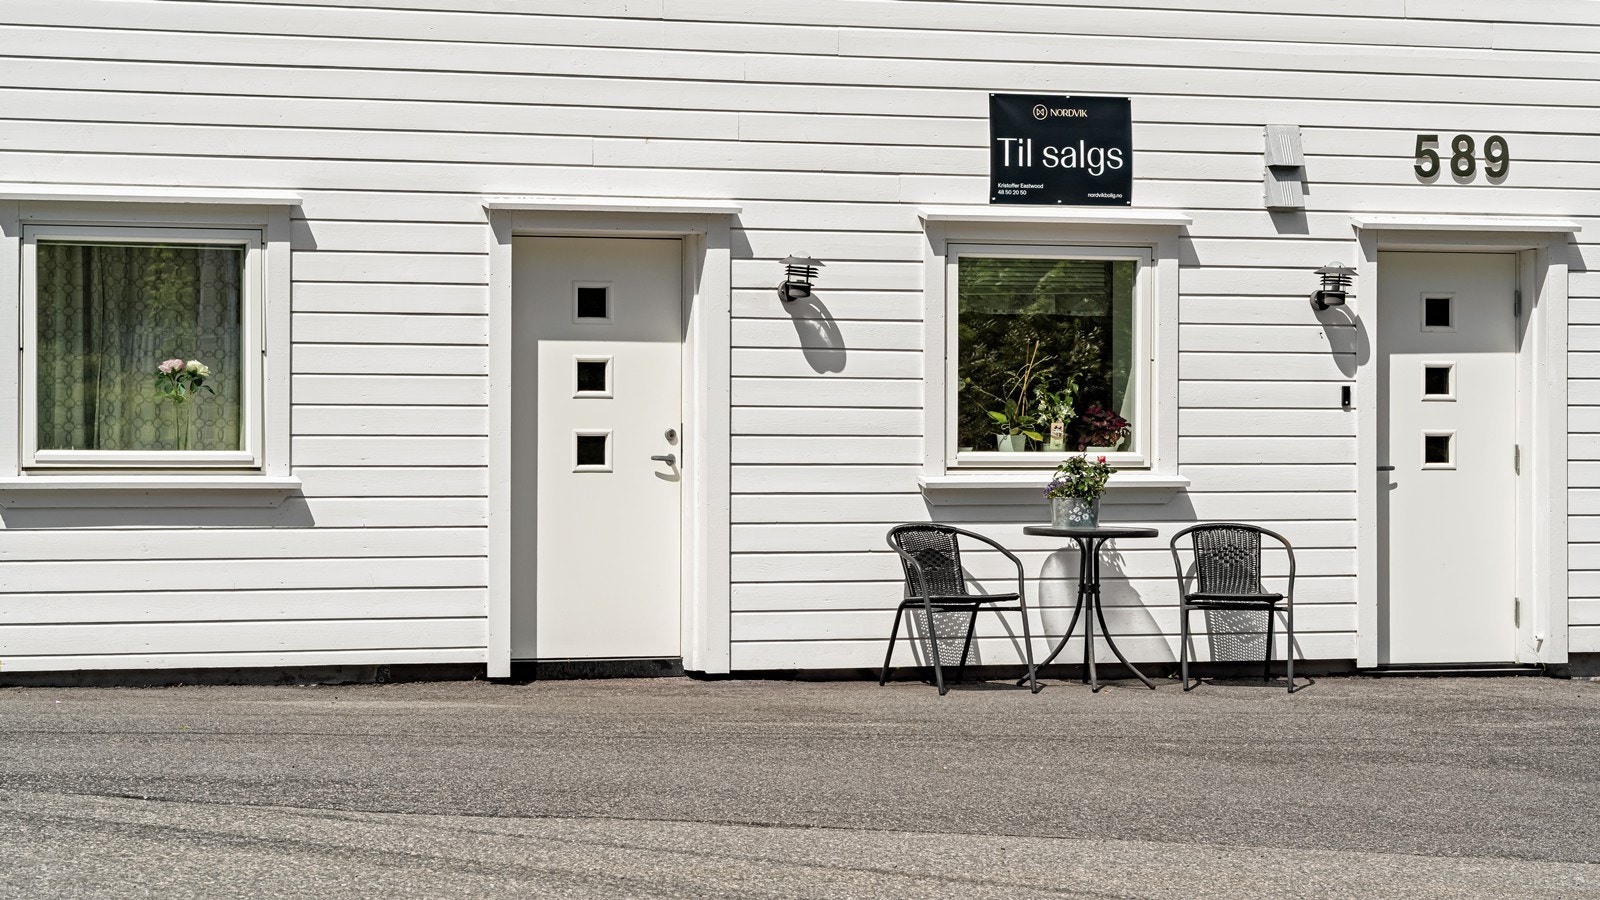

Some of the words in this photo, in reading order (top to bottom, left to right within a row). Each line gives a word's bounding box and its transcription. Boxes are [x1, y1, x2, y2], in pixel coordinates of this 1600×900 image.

[1050, 108, 1088, 118] NORDVIK
[997, 137, 1032, 167] Til
[1042, 139, 1124, 177] salgs
[1413, 133, 1510, 178] 589
